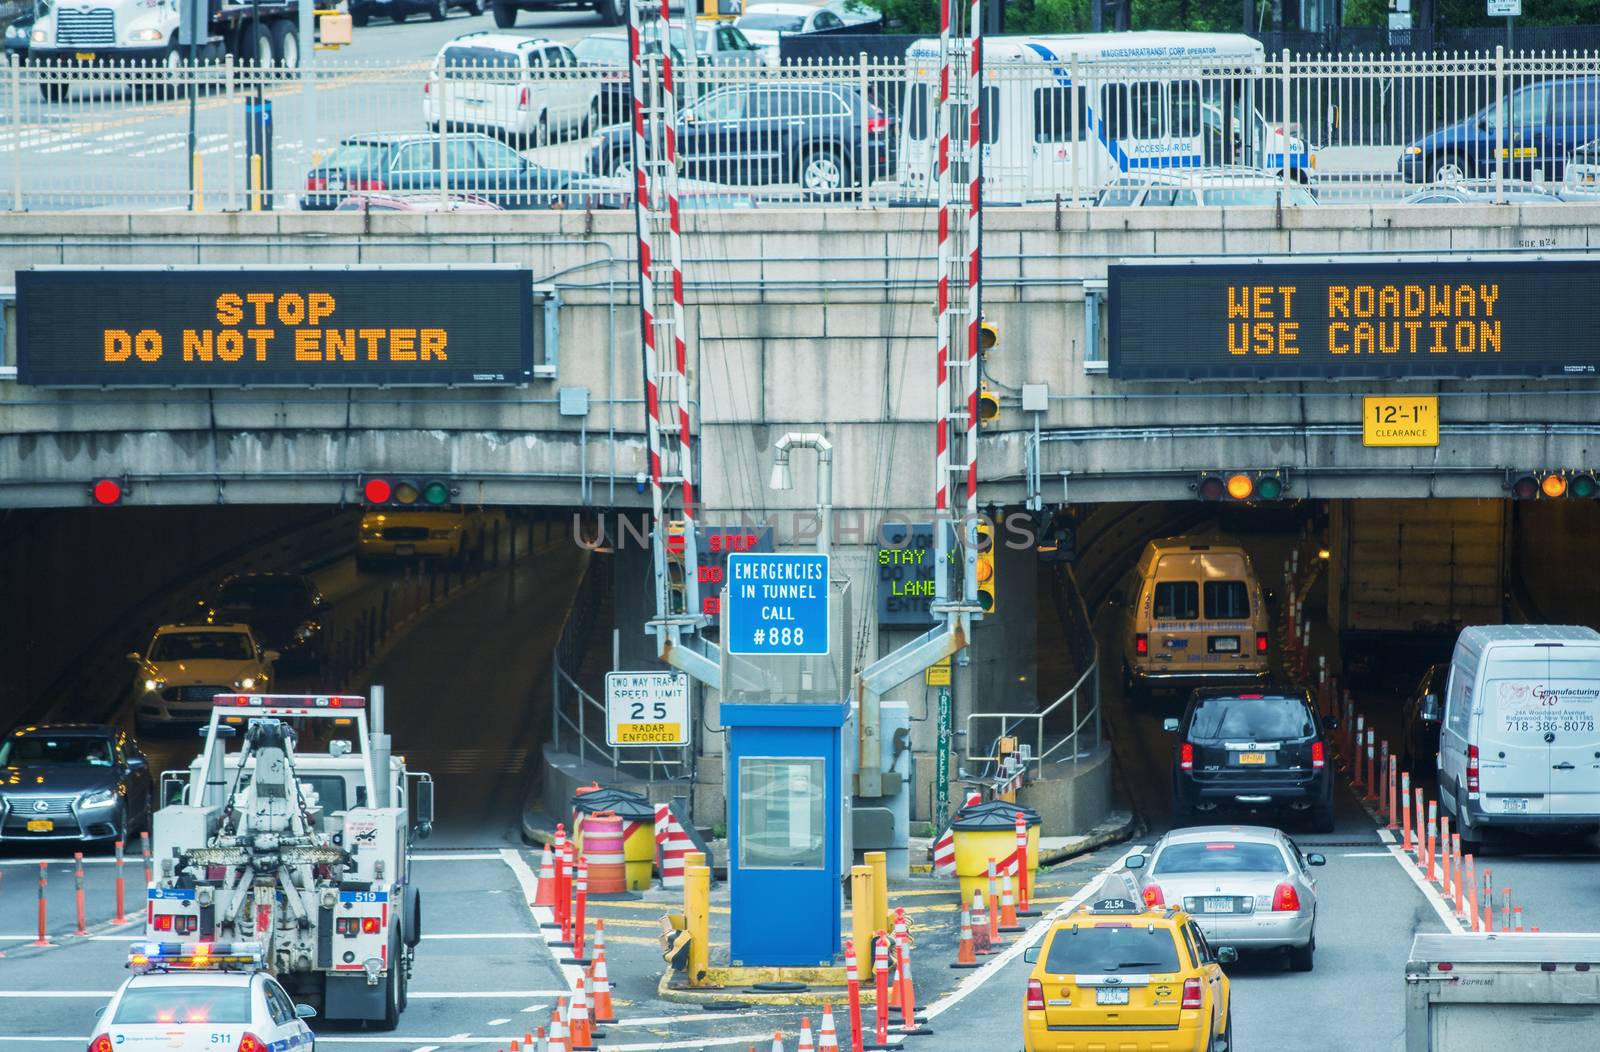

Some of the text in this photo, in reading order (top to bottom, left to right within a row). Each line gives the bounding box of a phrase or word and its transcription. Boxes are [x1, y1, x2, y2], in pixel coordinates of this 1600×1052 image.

[1128, 47, 1166, 57] PARATRANSIT
[1135, 143, 1191, 153] ACCESS--RDE
[1228, 284, 1498, 318] WET ROADWAY
[216, 293, 336, 326] STOP
[104, 328, 448, 362] DO NOT ENTER
[1228, 321, 1501, 355] USE CAUTION
[1375, 405, 1428, 423] 12'-1"
[1375, 429, 1428, 437] CLEARANCE
[710, 535, 758, 552] STOP
[879, 549, 925, 565] STAY
[735, 563, 822, 580] EMERGENCIES
[741, 585, 816, 599] IN TUNNEL
[893, 580, 936, 596] LANE
[762, 606, 795, 620] CALL
[754, 627, 804, 646] #888
[611, 678, 628, 687] TWO
[632, 678, 648, 687] WAY
[615, 690, 683, 699] SPEED LIMIT
[1544, 688, 1600, 697] manufacturing
[631, 702, 667, 720] 25
[632, 724, 665, 732] RADAR
[1506, 721, 1594, 732] 718-386-8078
[622, 734, 674, 742] ENFORCED
[355, 892, 377, 902] 519
[1104, 900, 1124, 909] 2L54
[211, 1033, 231, 1044] 511
